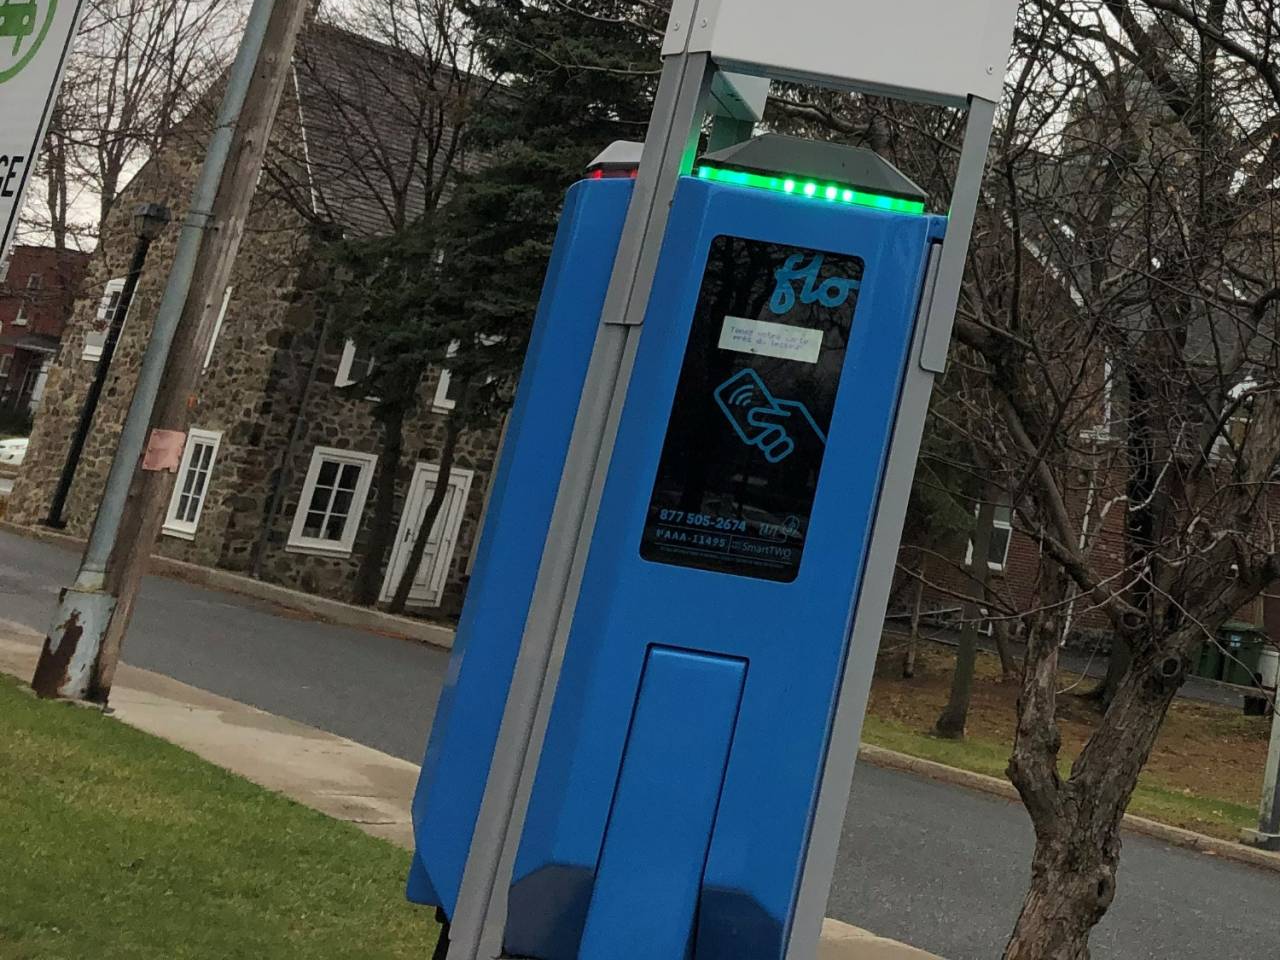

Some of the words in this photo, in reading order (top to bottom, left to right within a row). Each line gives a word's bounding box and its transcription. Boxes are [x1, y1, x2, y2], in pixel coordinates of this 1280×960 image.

[768, 253, 861, 314] flo
[659, 508, 685, 523] 877
[686, 512, 747, 532] 505-2674
